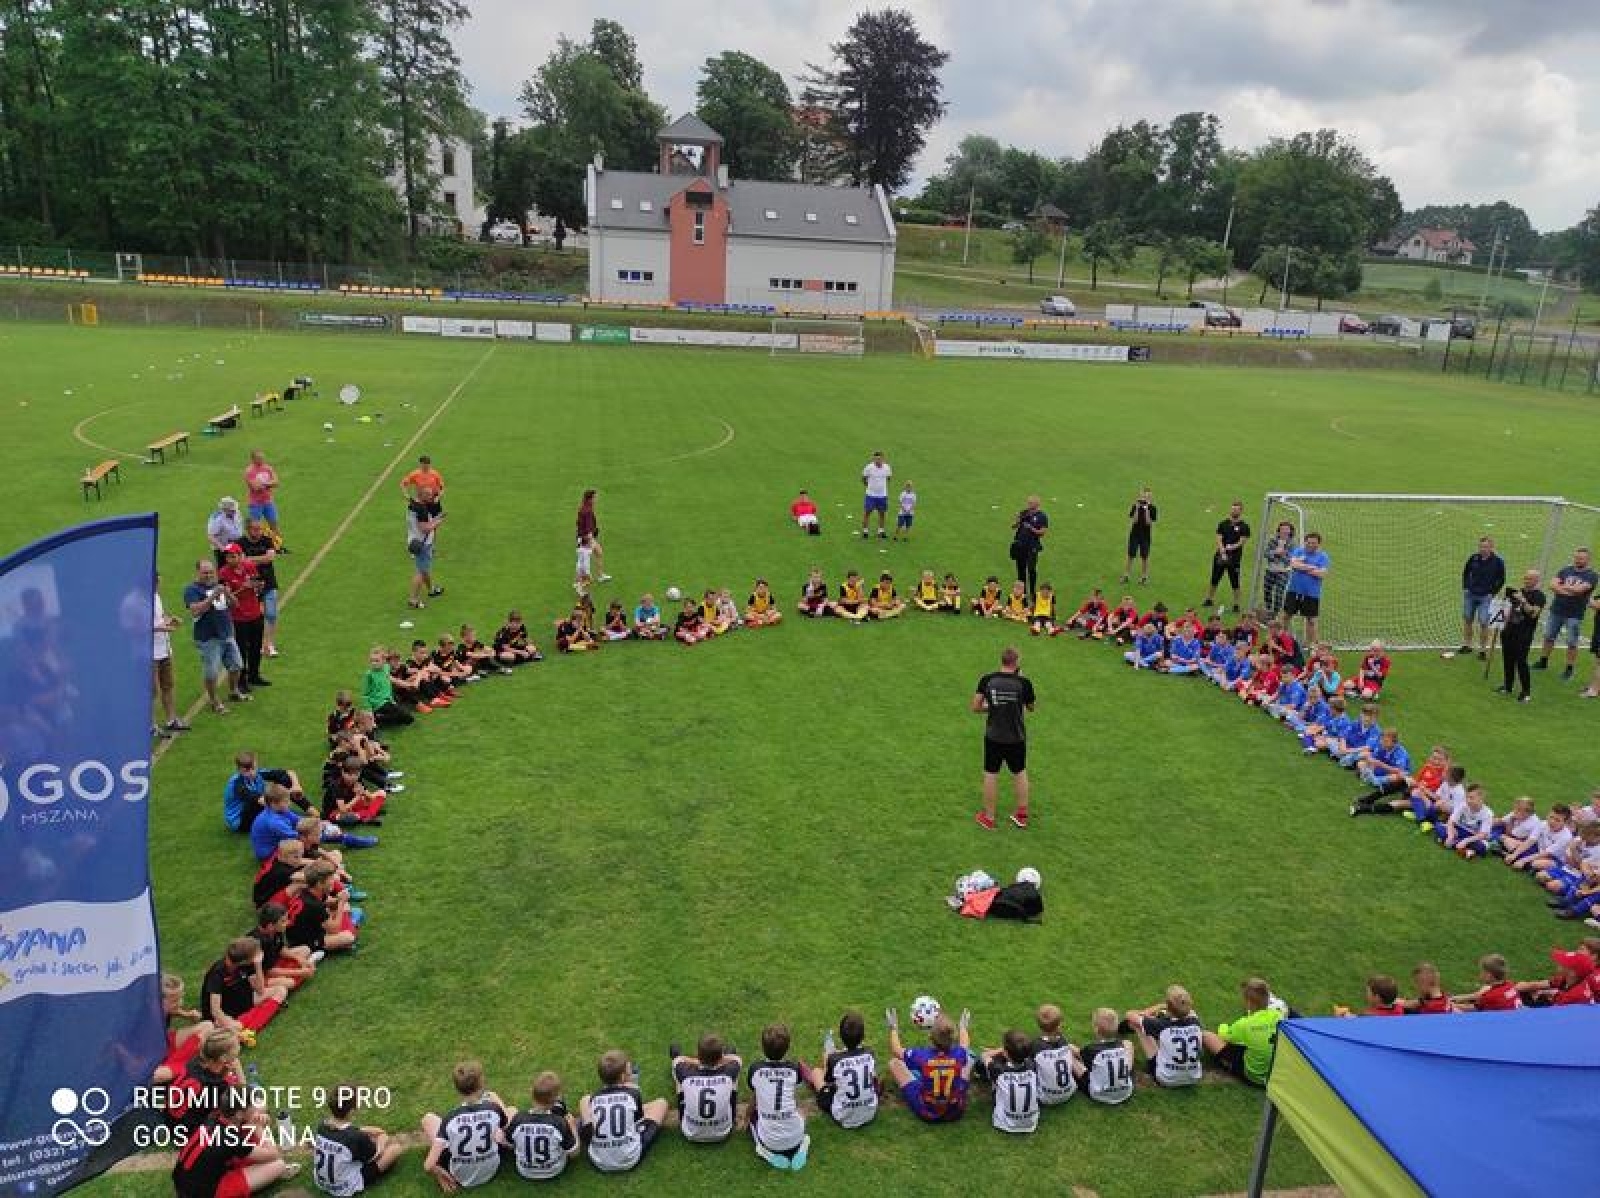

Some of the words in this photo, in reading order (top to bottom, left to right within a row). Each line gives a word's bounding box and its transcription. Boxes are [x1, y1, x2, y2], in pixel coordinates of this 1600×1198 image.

[18, 759, 149, 804] GOS
[21, 808, 99, 825] MSZANA
[1170, 1035, 1202, 1064] 33
[929, 1068, 955, 1097] 17
[1055, 1059, 1069, 1087] 8
[1107, 1058, 1129, 1087] 14
[699, 1087, 717, 1119] 6
[769, 1079, 784, 1111] 7
[1009, 1081, 1031, 1112] 17
[593, 1103, 627, 1139] 20
[457, 1122, 492, 1156] 23
[525, 1135, 552, 1164] 19
